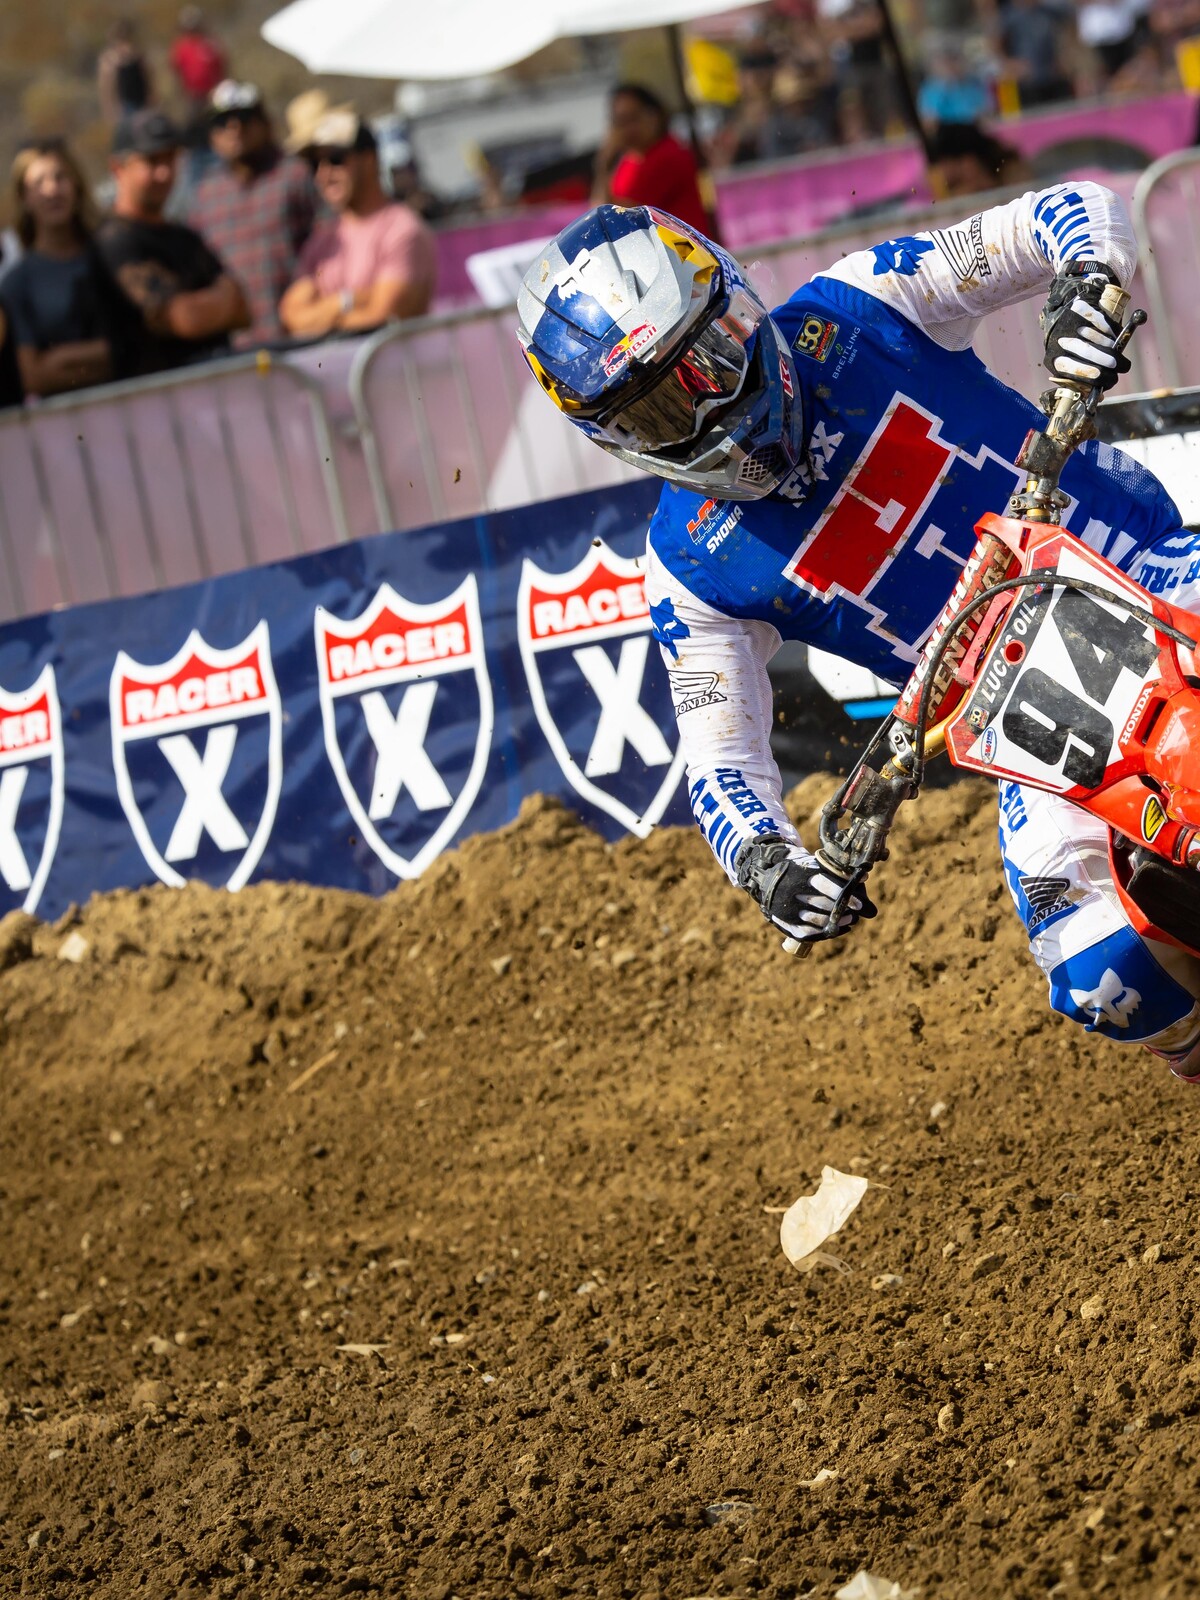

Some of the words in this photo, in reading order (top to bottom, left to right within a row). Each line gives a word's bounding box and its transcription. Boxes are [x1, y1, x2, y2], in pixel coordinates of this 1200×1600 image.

[604, 349, 632, 377] Red
[631, 326, 657, 352] Bull
[832, 326, 861, 379] BREITLING
[706, 504, 744, 555] SHOWA
[532, 581, 650, 637] RACE
[902, 537, 988, 708] RENTHAL
[1013, 600, 1038, 637] OIL
[328, 620, 467, 684] RACER
[124, 666, 262, 725] RACER
[572, 635, 674, 778] X
[1003, 588, 1162, 790] 94
[1120, 686, 1153, 746] HONDA
[360, 680, 454, 821] X
[157, 723, 250, 862] X
[1028, 899, 1075, 931] ONDA
